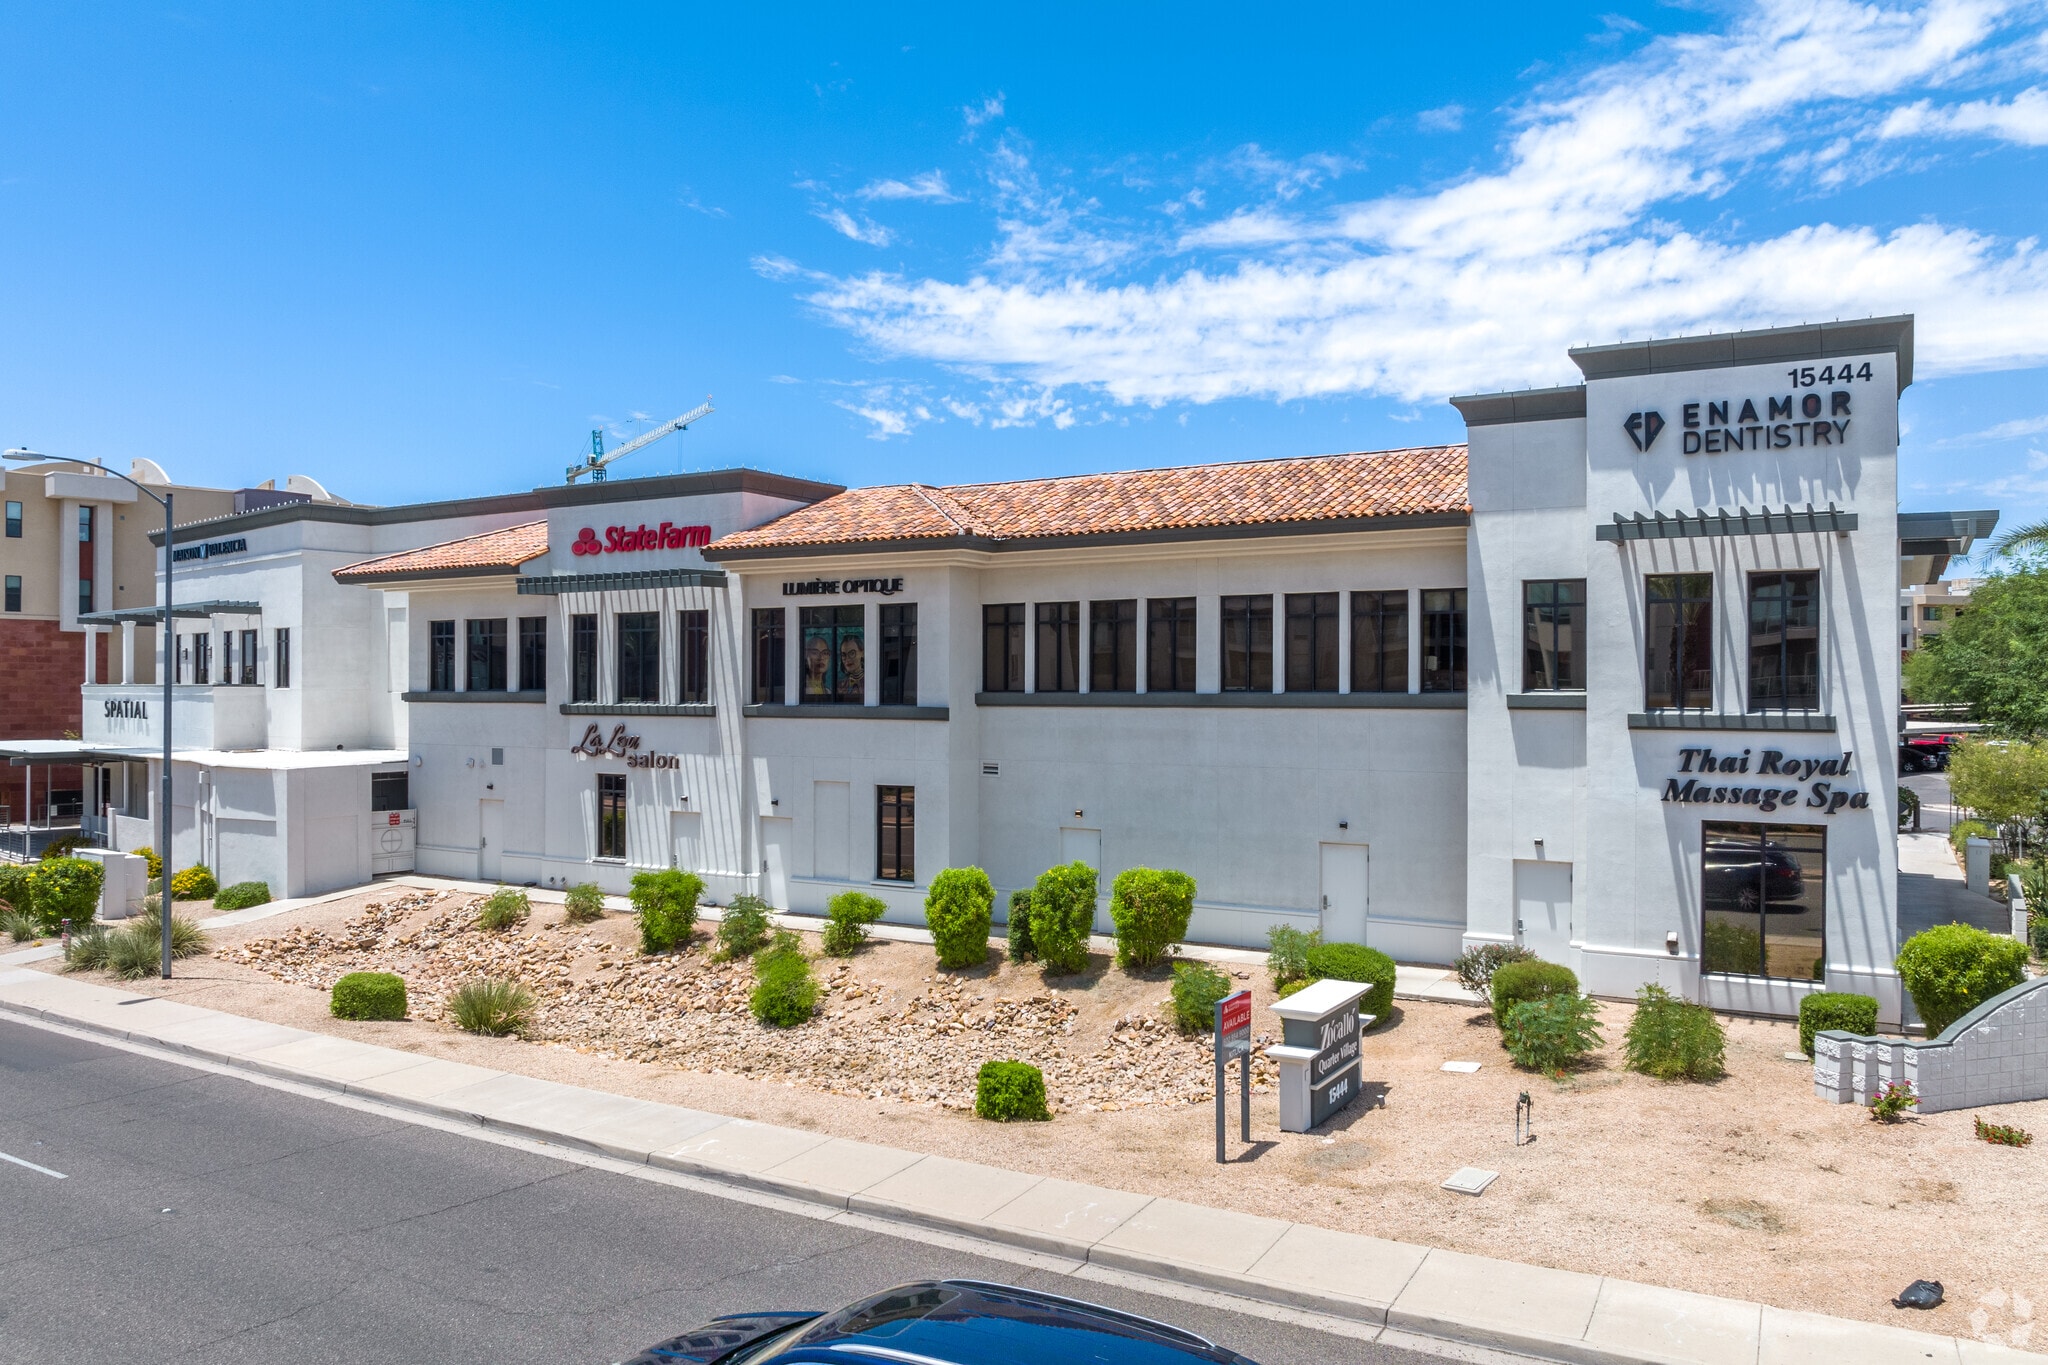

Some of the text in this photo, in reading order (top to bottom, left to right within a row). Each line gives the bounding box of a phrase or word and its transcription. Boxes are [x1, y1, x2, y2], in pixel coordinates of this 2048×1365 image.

[1788, 362, 1873, 388] 15444
[1683, 391, 1852, 428] ENAMOR
[1683, 419, 1851, 455] DENTISTRY
[782, 578, 904, 596] LUMIÈRE OPTIQUE
[104, 700, 148, 720] SPATIAL
[571, 723, 602, 757] La
[627, 750, 680, 769] salon
[1677, 748, 1853, 781] Thai Royal
[1661, 778, 1870, 815] Massage Spa
[1223, 1010, 1250, 1031] AVAILABLE
[1318, 1041, 1358, 1075] Quarter Village
[1328, 1078, 1348, 1105] 15444
